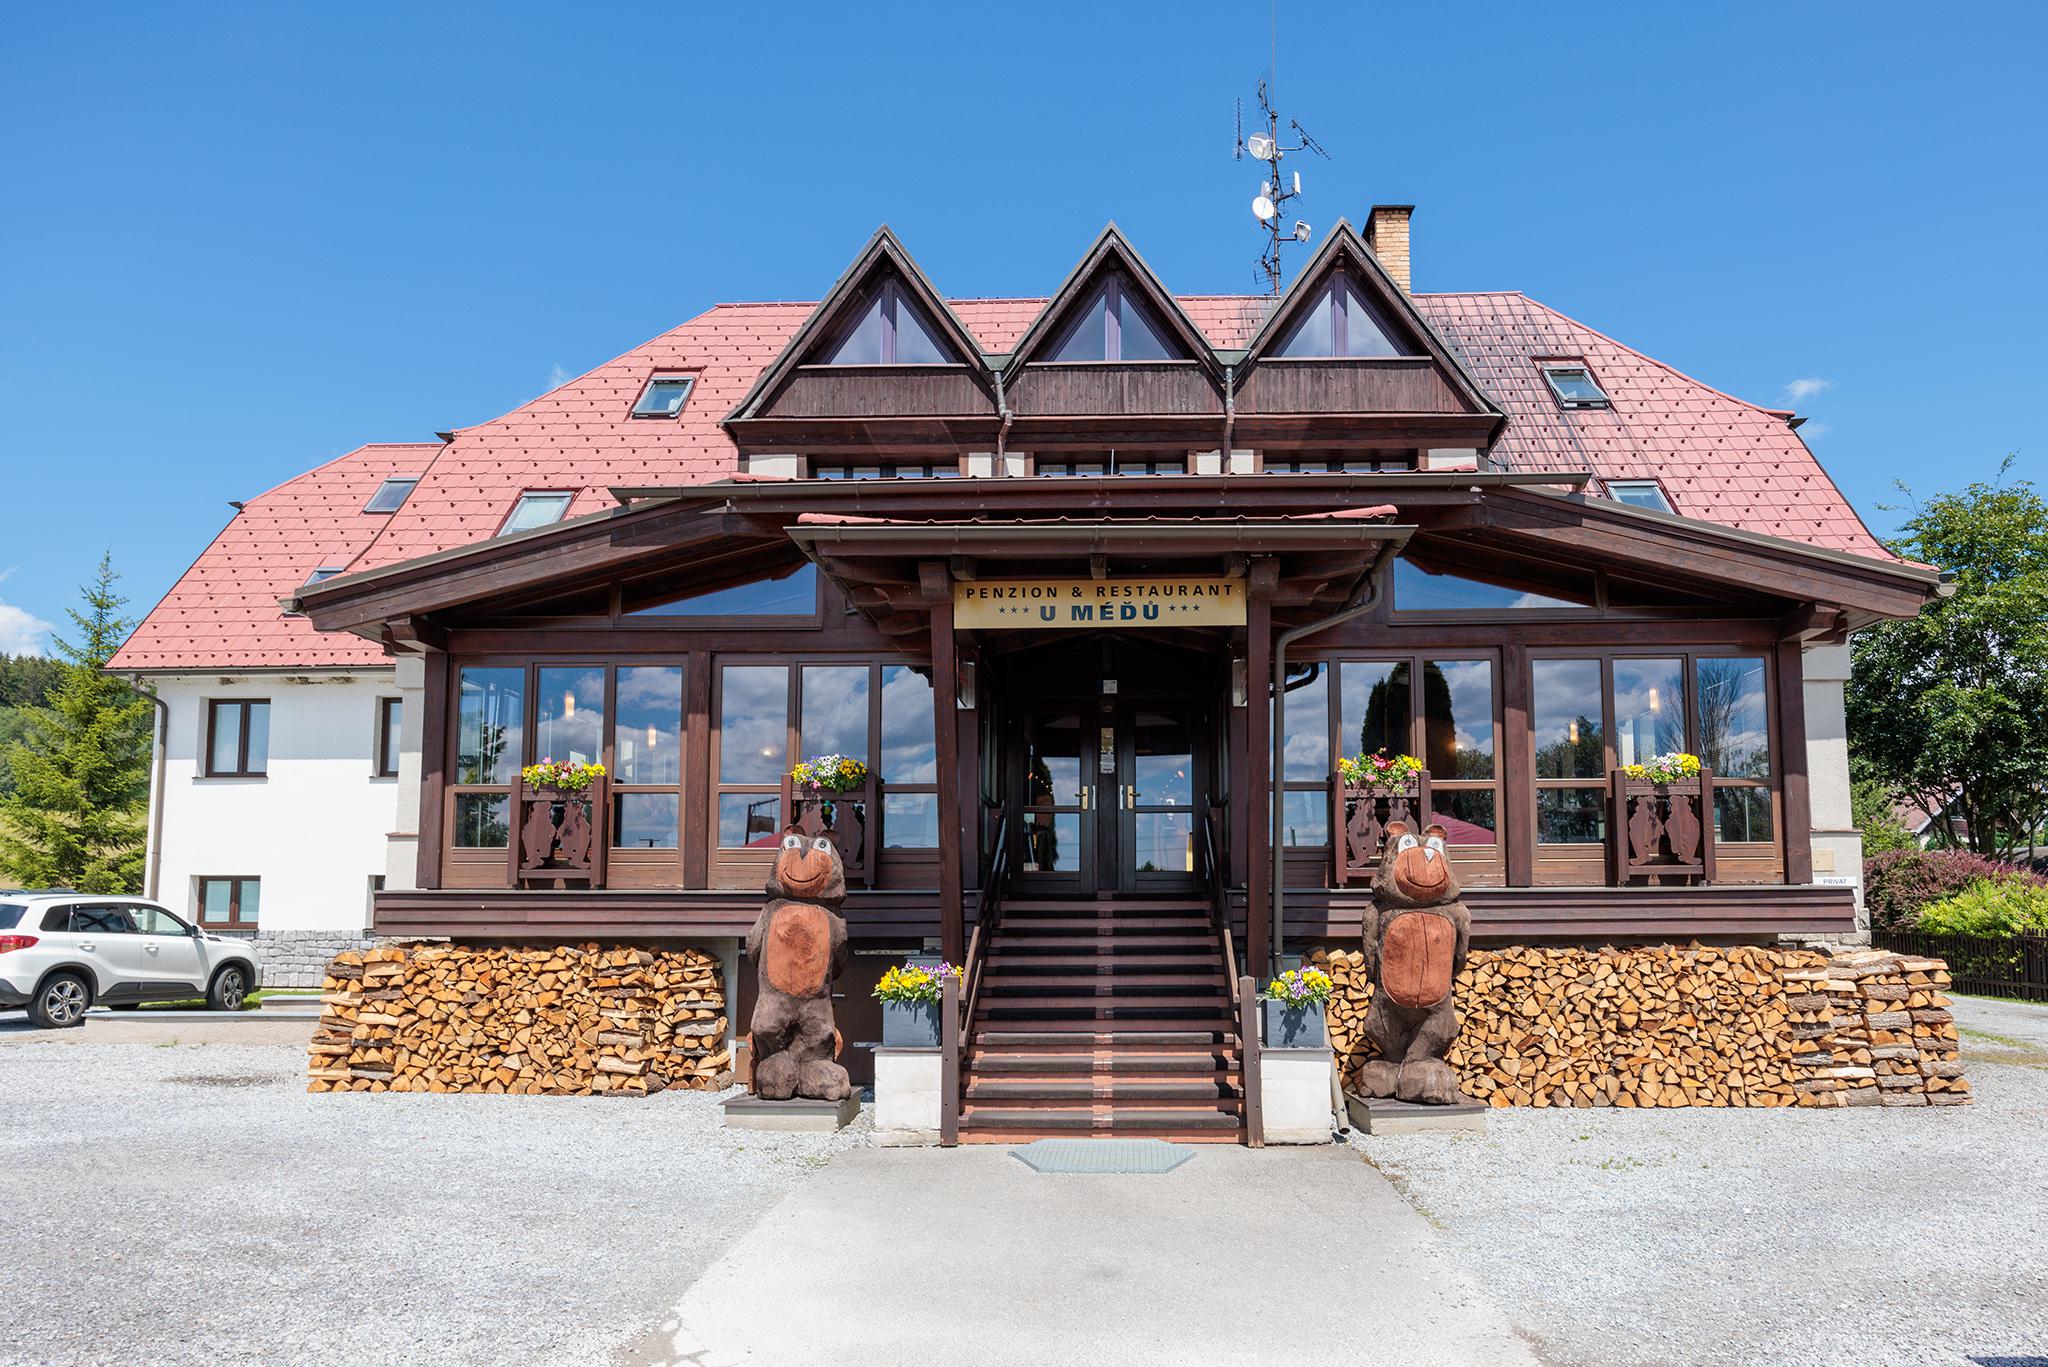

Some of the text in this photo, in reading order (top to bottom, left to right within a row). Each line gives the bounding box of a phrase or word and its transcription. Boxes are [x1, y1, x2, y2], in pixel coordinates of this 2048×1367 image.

[966, 584, 1233, 599] PENZION & RESTAURANT
[1040, 605, 1056, 621] U
